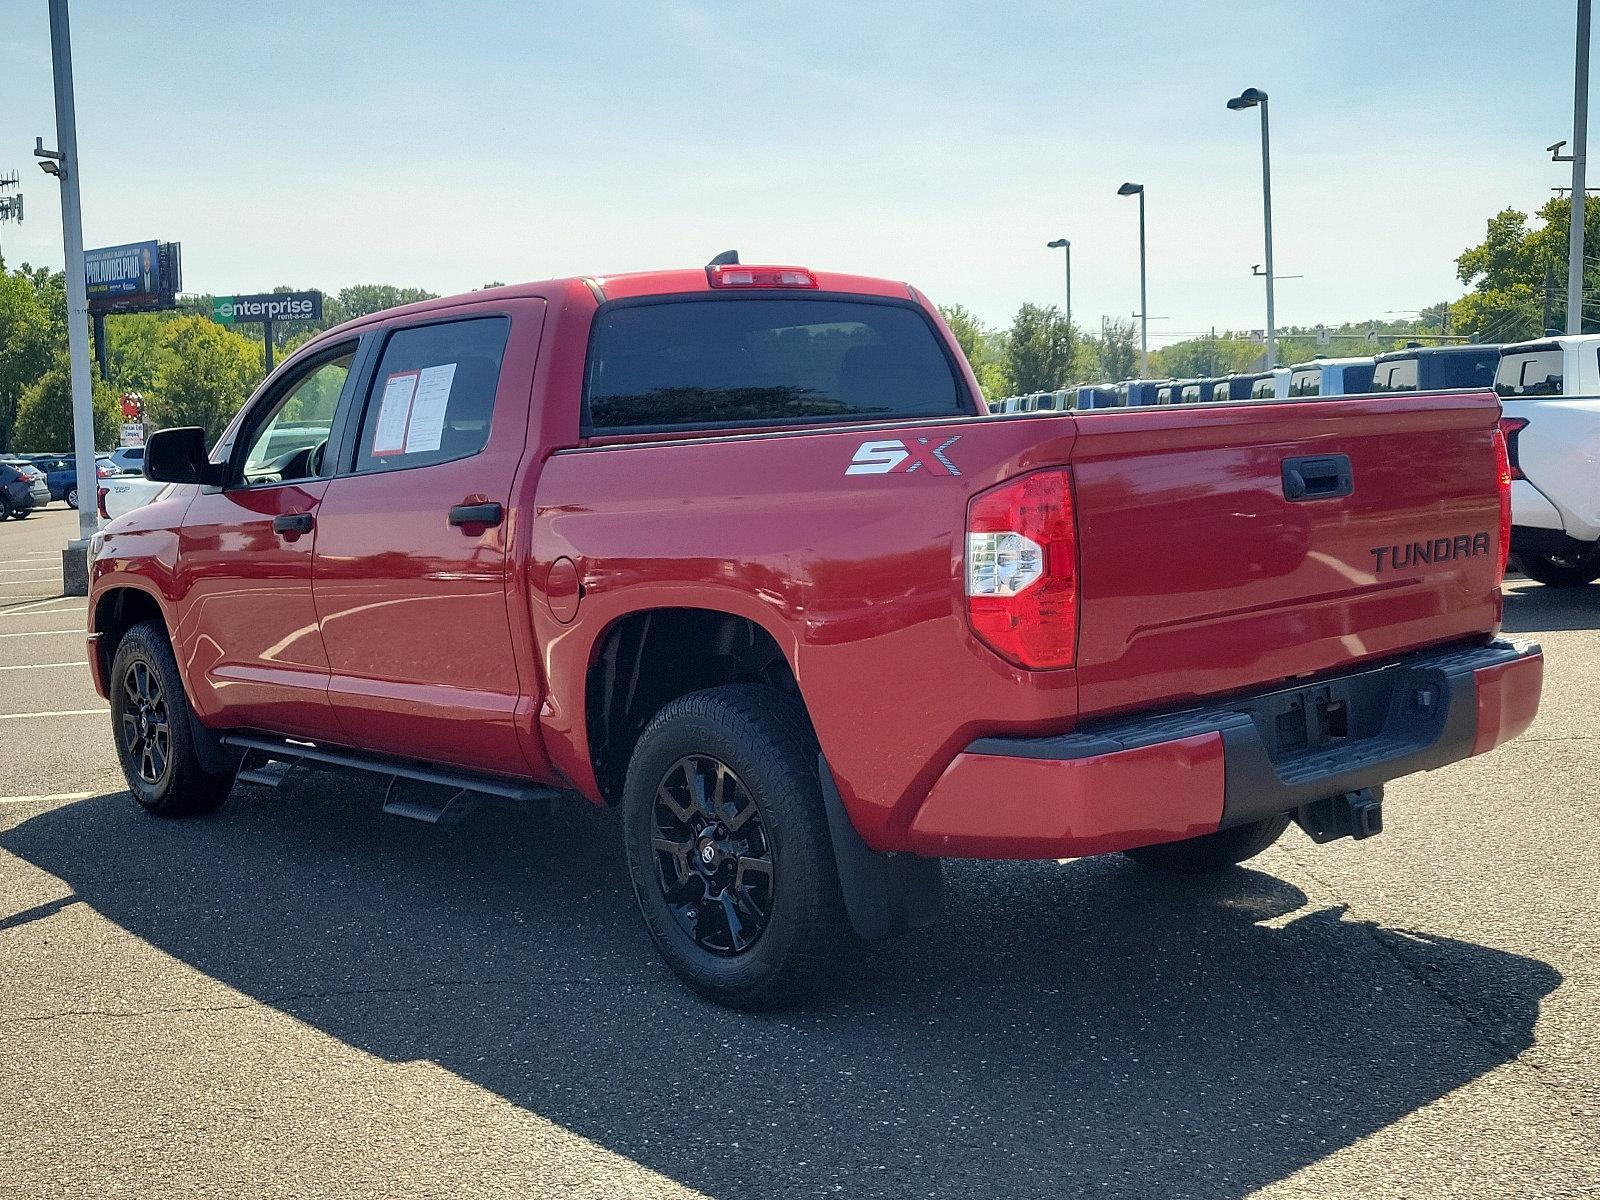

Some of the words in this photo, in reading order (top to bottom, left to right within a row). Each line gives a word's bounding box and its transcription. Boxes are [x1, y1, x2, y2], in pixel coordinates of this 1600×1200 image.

[86, 256, 140, 283] PHILAWDELPHIA
[217, 297, 313, 318] enterprise
[1370, 530, 1490, 572] TUNDRA
